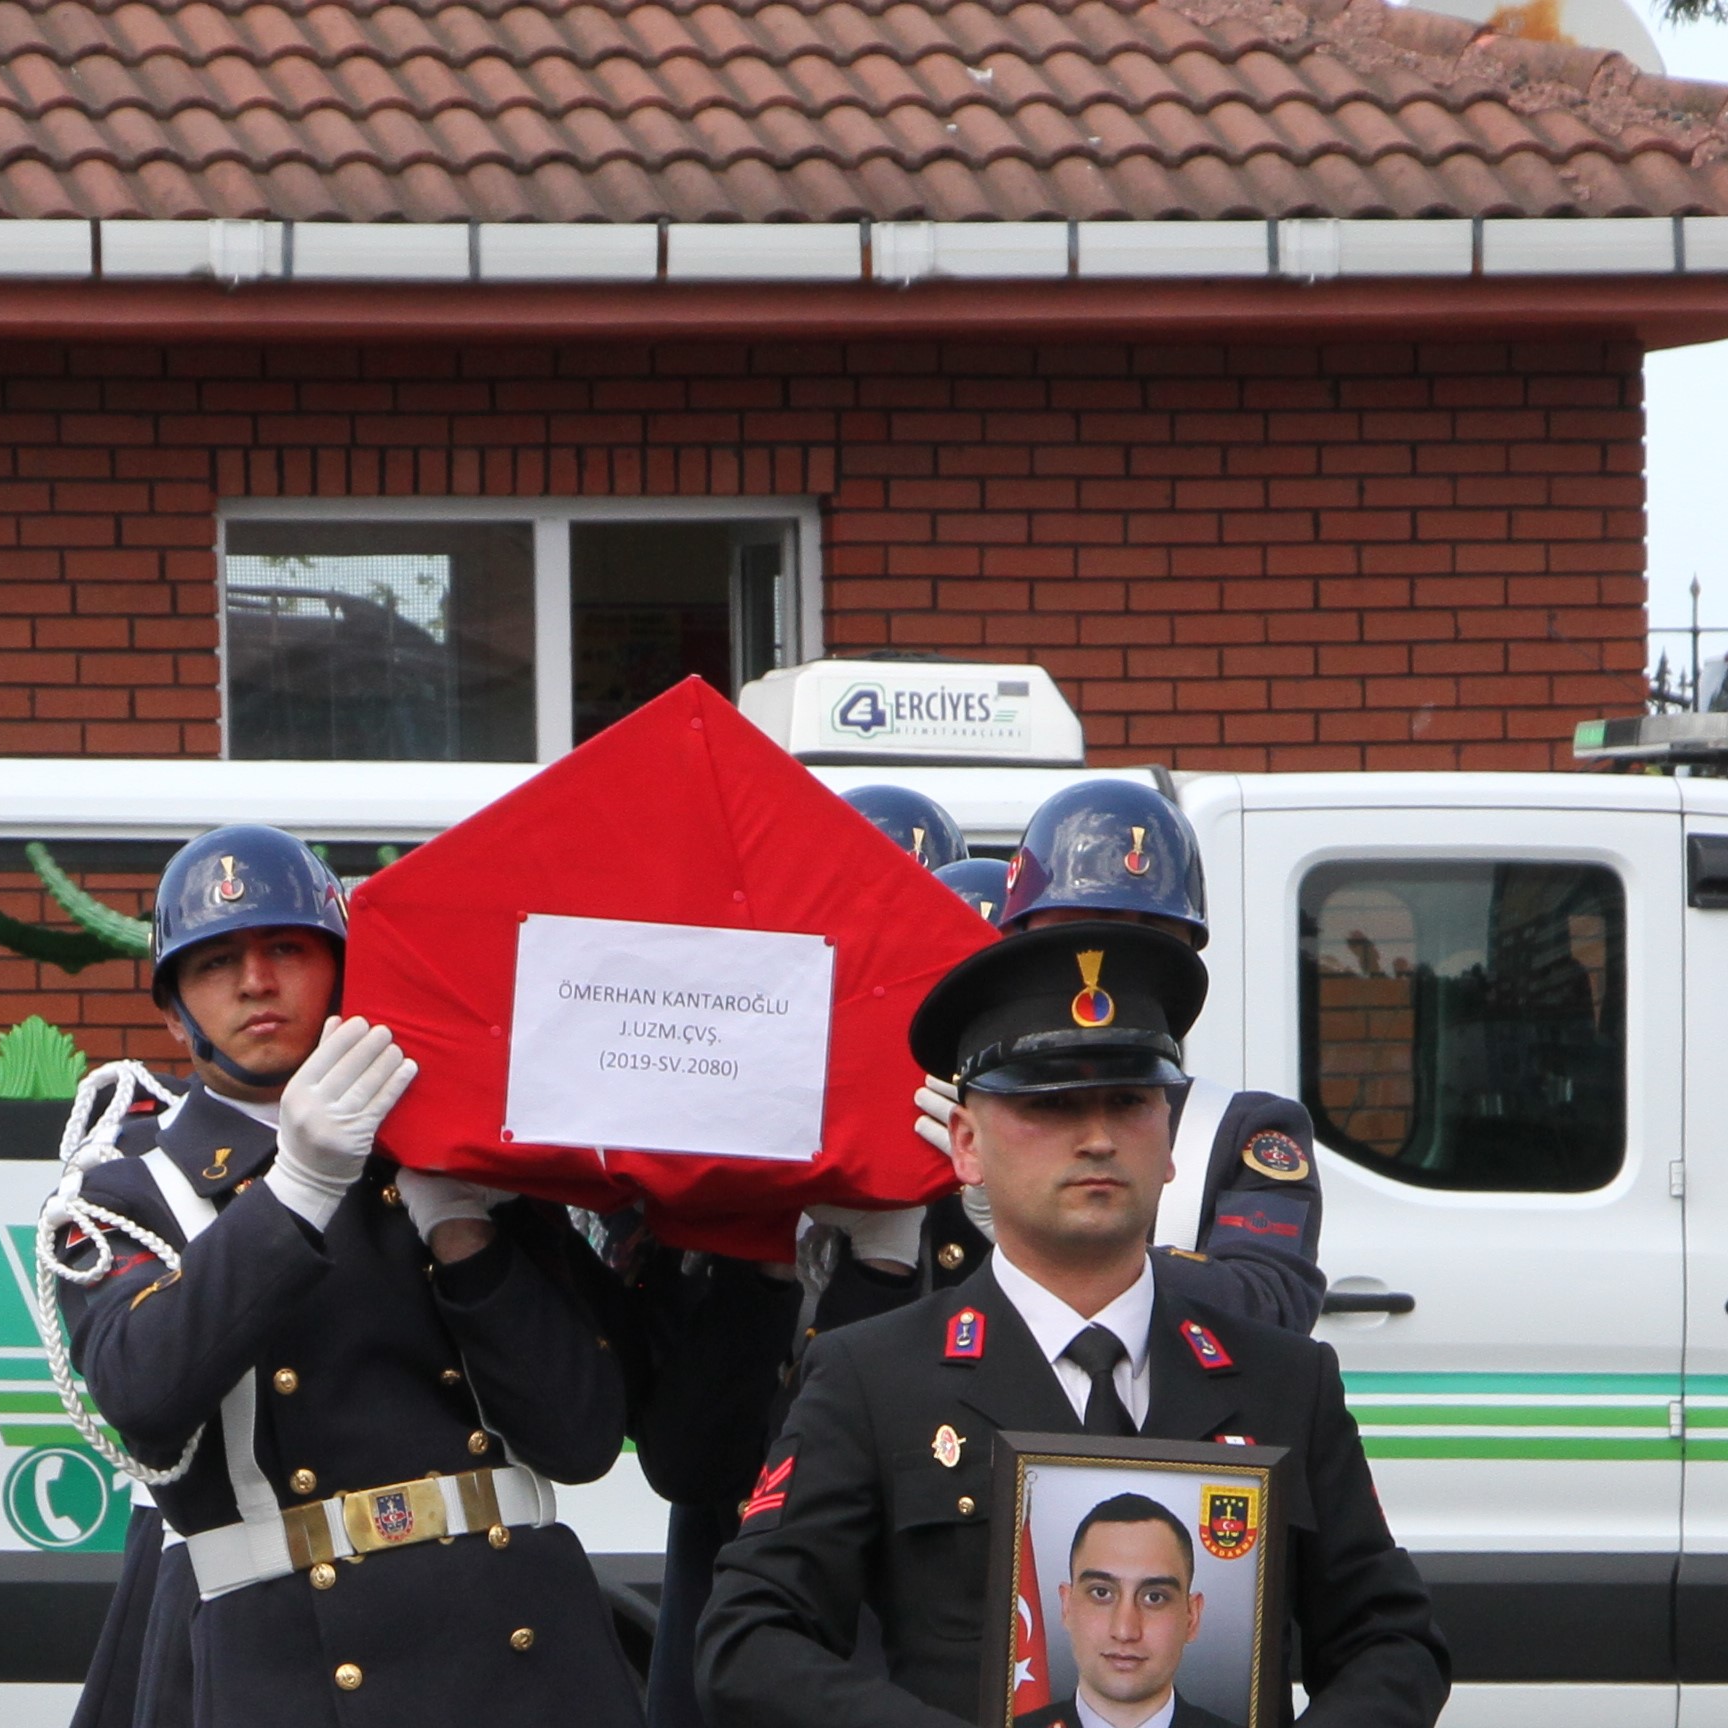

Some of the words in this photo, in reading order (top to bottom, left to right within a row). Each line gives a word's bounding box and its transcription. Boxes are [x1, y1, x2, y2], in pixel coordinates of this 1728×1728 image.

[894, 685, 992, 723] ERCİYES
[558, 979, 657, 1006] ÖMERHAN
[661, 990, 790, 1016] KANTAROĞLU
[618, 1020, 723, 1046] J.UZM.ÇVŞ.
[598, 1050, 740, 1080] (2019-SV.2080)
